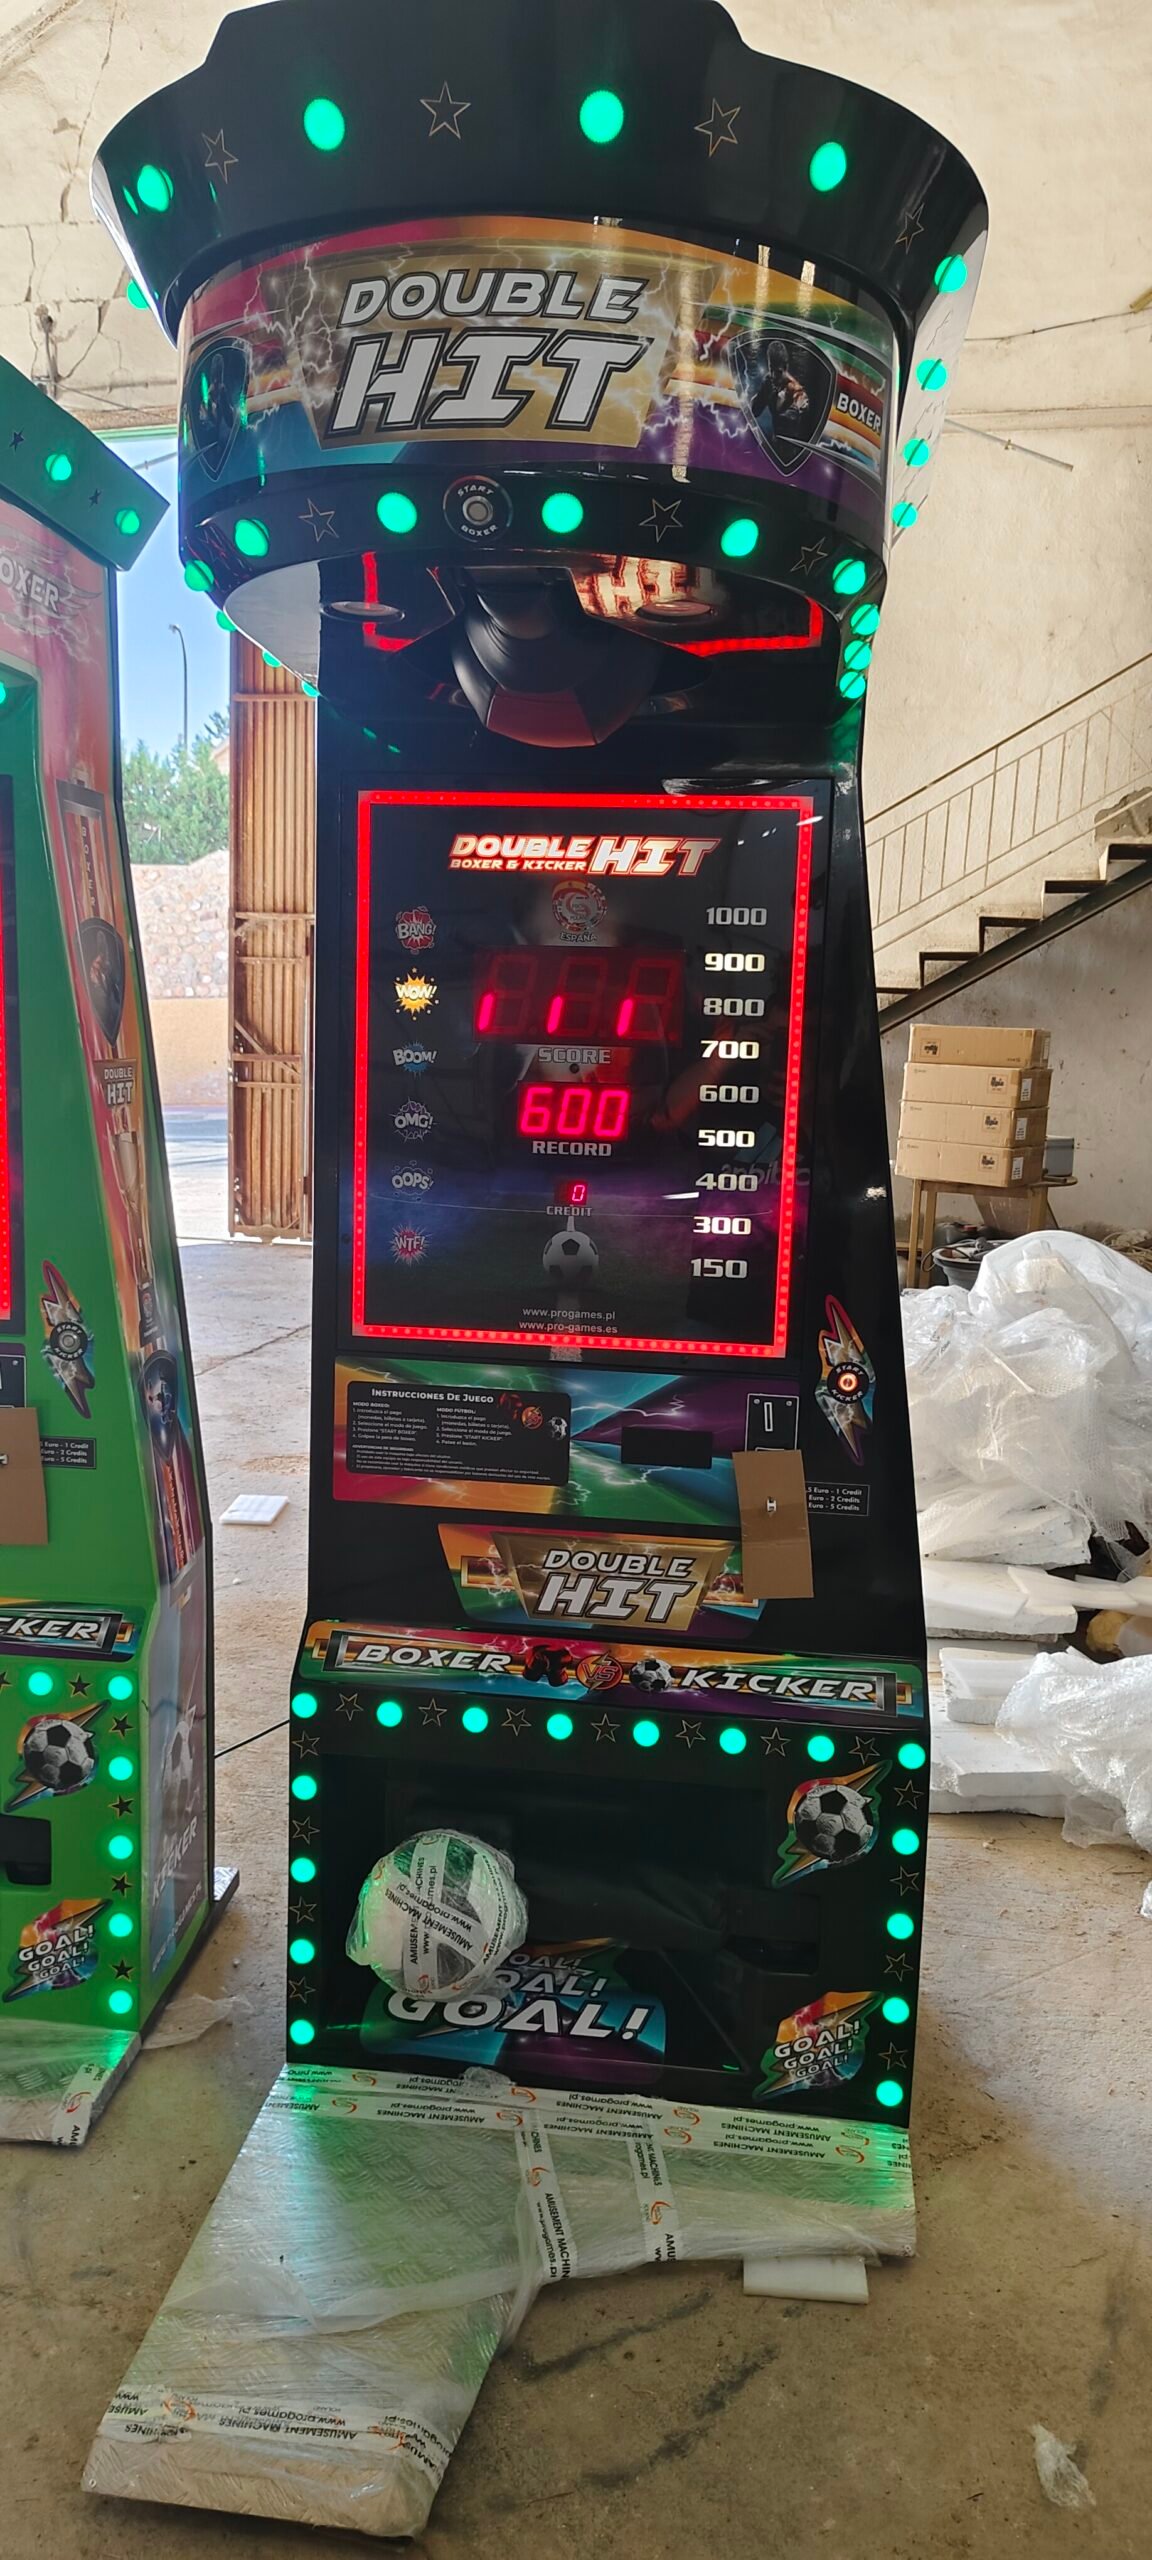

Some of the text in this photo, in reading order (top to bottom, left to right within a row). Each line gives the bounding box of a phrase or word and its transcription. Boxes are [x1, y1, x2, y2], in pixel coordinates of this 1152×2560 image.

[342, 271, 648, 325] DOUBLE
[328, 330, 652, 435] HIT
[836, 393, 882, 434] BOXER
[457, 484, 494, 496] START
[460, 523, 498, 537] BOXER
[0, 556, 59, 612] OXER
[451, 835, 721, 876] DOUBLE HIT
[450, 859, 588, 872] BOXER & KICKER
[706, 907, 767, 927] 1000
[397, 923, 436, 939] BANG!
[704, 952, 766, 973] 900
[395, 985, 437, 1000] WOW!
[703, 997, 765, 1017] 800
[392, 1049, 437, 1065] BOOM!
[538, 1047, 611, 1064] SCORE
[700, 1040, 760, 1060] 700
[104, 1067, 132, 1080] DOUBLE
[107, 1082, 132, 1105] HIT
[699, 1085, 760, 1104] 600
[394, 1112, 433, 1129] OMG!
[520, 1086, 631, 1137] 600
[698, 1129, 755, 1148] 500
[532, 1140, 612, 1157] RECORD
[391, 1172, 433, 1190] OOPS!
[695, 1173, 758, 1192] 400
[572, 1185, 586, 1201] 0
[546, 1205, 593, 1217] CREDIT
[693, 1216, 752, 1235] 300
[394, 1235, 425, 1251] WTF!
[690, 1257, 748, 1279] 150
[523, 1308, 616, 1321] www.progames.pl
[56, 1325, 82, 1334] START
[519, 1321, 618, 1334] www.pro-games.es
[55, 1347, 83, 1359] KICKER
[835, 1364, 865, 1376] START
[831, 1389, 863, 1402] KICKER
[836, 1503, 860, 1511] Credits
[837, 1496, 860, 1504] Credits
[542, 1548, 696, 1579] DOUBLE
[536, 1574, 697, 1622] HIT
[0, 1616, 99, 1639] KER
[356, 1644, 877, 1701] BOXER VS KICKER
[397, 1882, 472, 1932] www.progames.pl
[385, 1888, 473, 1951] AMUSEMENT MACHINES
[19, 1925, 94, 1962] GOAL!
[28, 1942, 88, 1972] GOAL!
[509, 1953, 583, 1969] OAL!
[39, 1957, 85, 1978] GOAL!
[497, 1970, 607, 1998] OAL!
[388, 1994, 650, 2040] GOAL!
[774, 2020, 860, 2058] GOAL!
[784, 2039, 852, 2069] GOAL!
[796, 2055, 848, 2077] GOAL!
[396, 2083, 444, 2093] MACHINES
[409, 2077, 464, 2089] rogames.pl
[390, 2102, 476, 2114] www.progames.pl
[556, 2101, 663, 2120] AMUSEMENT MACHINES
[569, 2093, 653, 2109] www.progames.pl
[376, 2108, 485, 2124] AMUSEMENT MACHINES
[556, 2117, 643, 2130] www.progames.pl
[733, 2116, 820, 2132] www.progames.pl
[544, 2123, 653, 2140] AMUSEMENT MACHINES
[721, 2122, 831, 2142] AMUSEMENT MACHINES
[725, 2133, 814, 2148] www.progames.pl
[530, 2131, 542, 2153] CHINES
[713, 2140, 825, 2159] AMUSEMENT MACHINES
[635, 2142, 649, 2179] rogames.pl
[647, 2150, 663, 2186] MACHINES
[545, 2193, 571, 2280] AMUSEMENT MACHIN
[108, 2404, 149, 2416] AMUSE
[283, 2426, 358, 2441] AMUSEMENT
